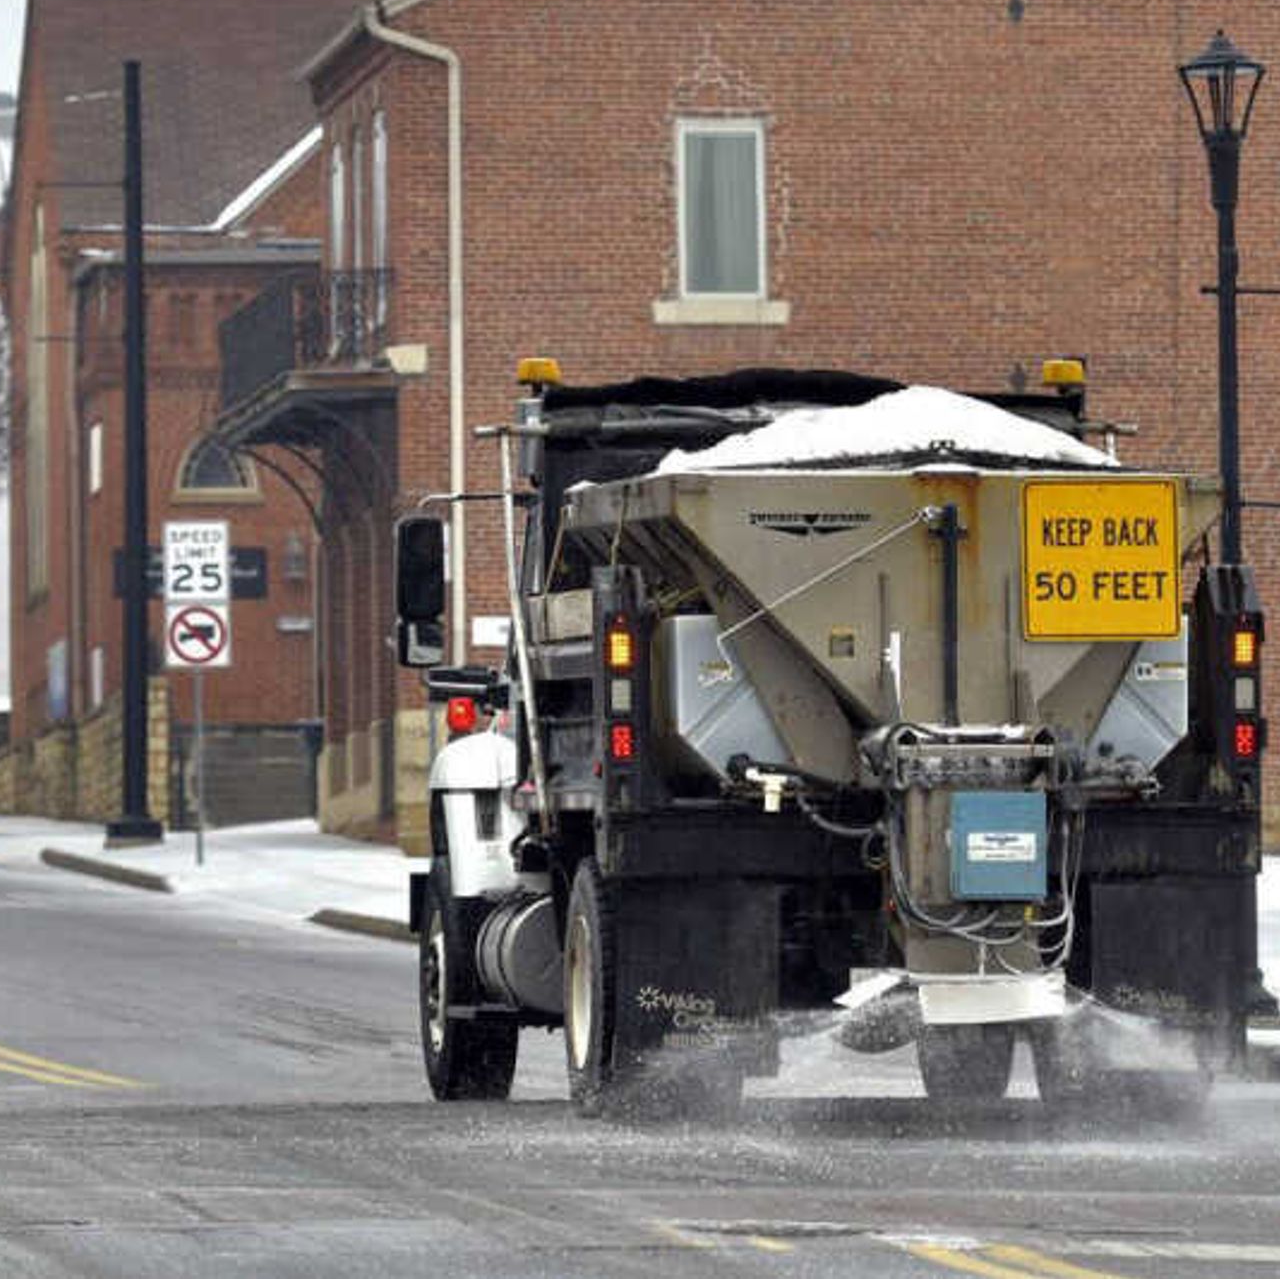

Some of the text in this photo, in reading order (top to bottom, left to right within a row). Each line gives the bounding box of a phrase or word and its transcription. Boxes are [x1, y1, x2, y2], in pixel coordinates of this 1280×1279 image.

[171, 530, 222, 543] SPEED
[1043, 518, 1159, 546] KEEP BACK
[174, 546, 216, 559] LIMIT
[172, 563, 222, 593] 25
[1036, 571, 1168, 601] 50 FEET
